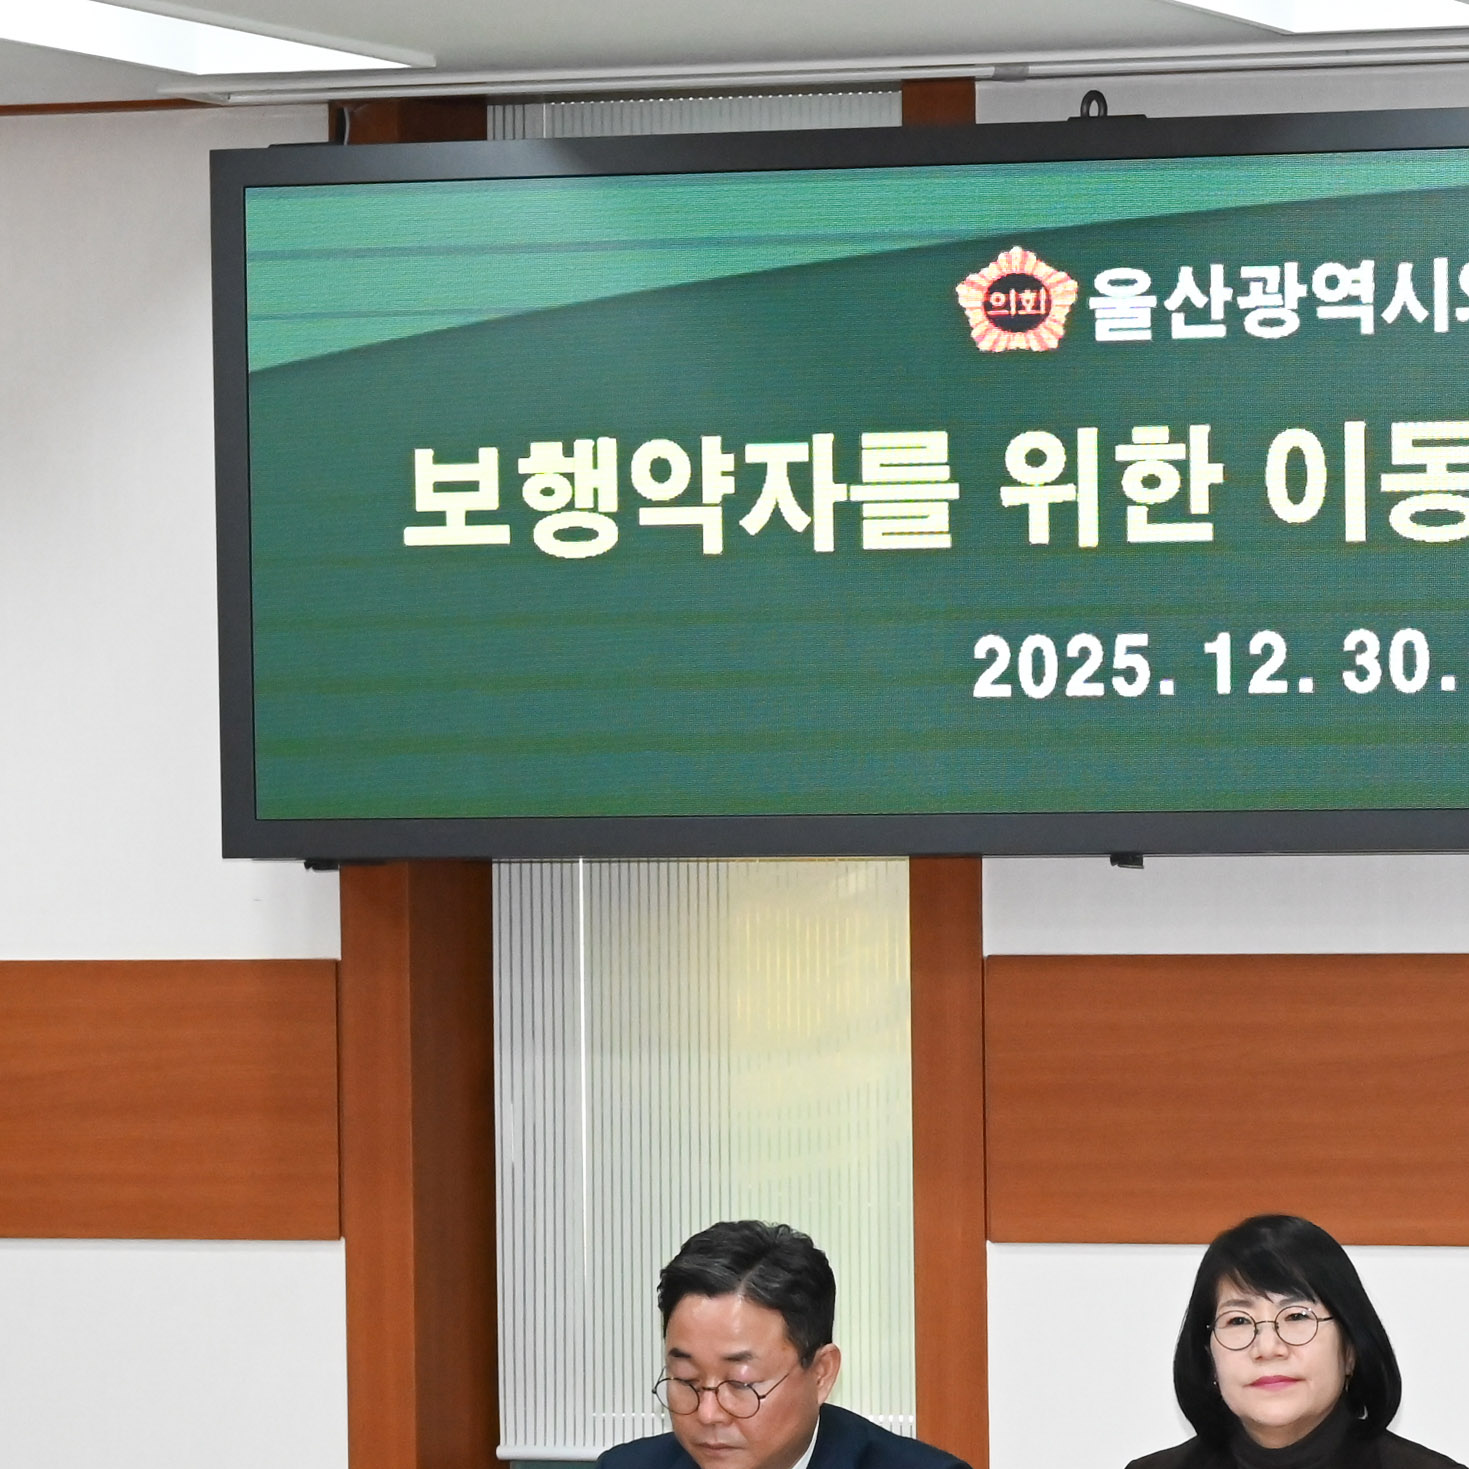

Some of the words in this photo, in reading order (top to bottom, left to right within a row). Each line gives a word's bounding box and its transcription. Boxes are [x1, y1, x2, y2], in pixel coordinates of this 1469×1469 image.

[986, 286, 1047, 318] 의회
[403, 431, 960, 559] 보행약자를
[1000, 424, 1224, 548] 위한
[972, 632, 1176, 699] 2025.
[1203, 630, 1314, 695] 12.
